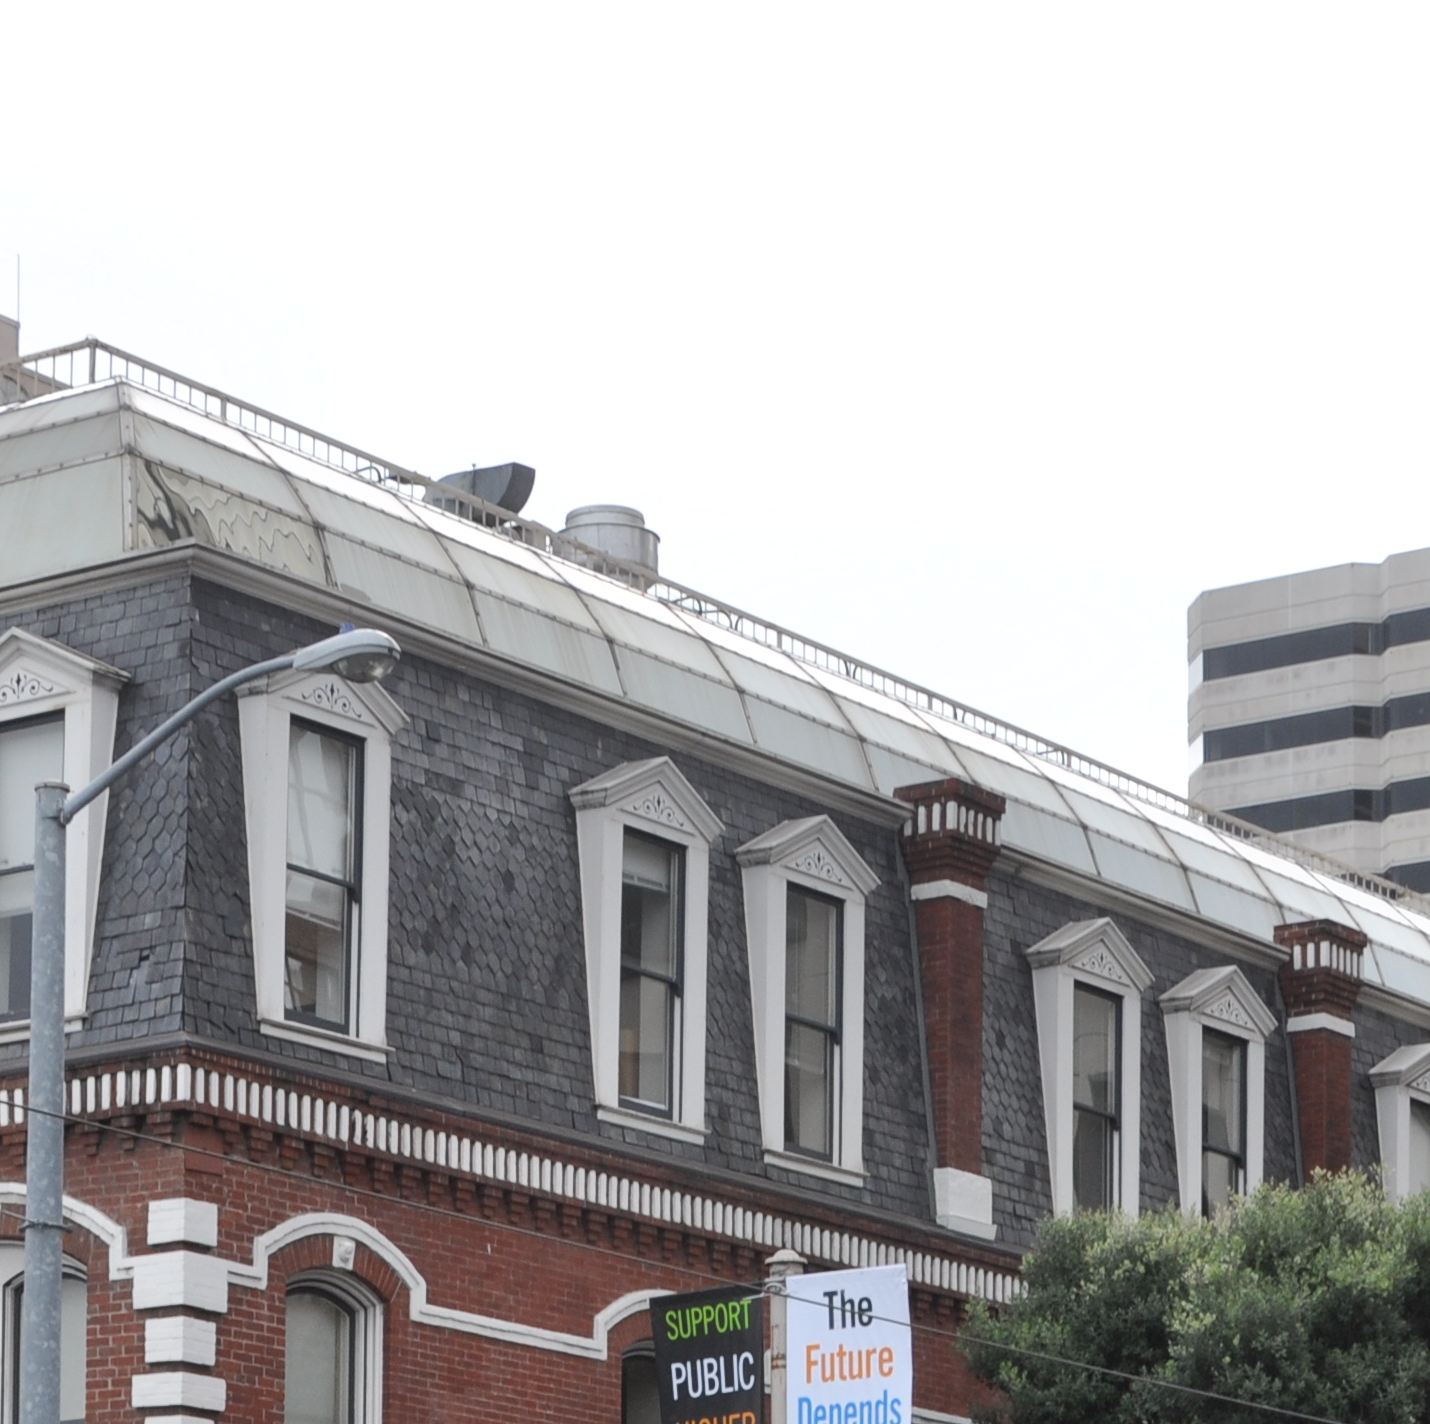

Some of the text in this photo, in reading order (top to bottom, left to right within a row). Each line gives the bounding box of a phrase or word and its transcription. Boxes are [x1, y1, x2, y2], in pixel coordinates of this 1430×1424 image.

[665, 1298, 752, 1341] SUPPORT
[822, 1289, 873, 1330] The
[671, 1351, 755, 1401] PUBLIC
[806, 1343, 894, 1384] Future
